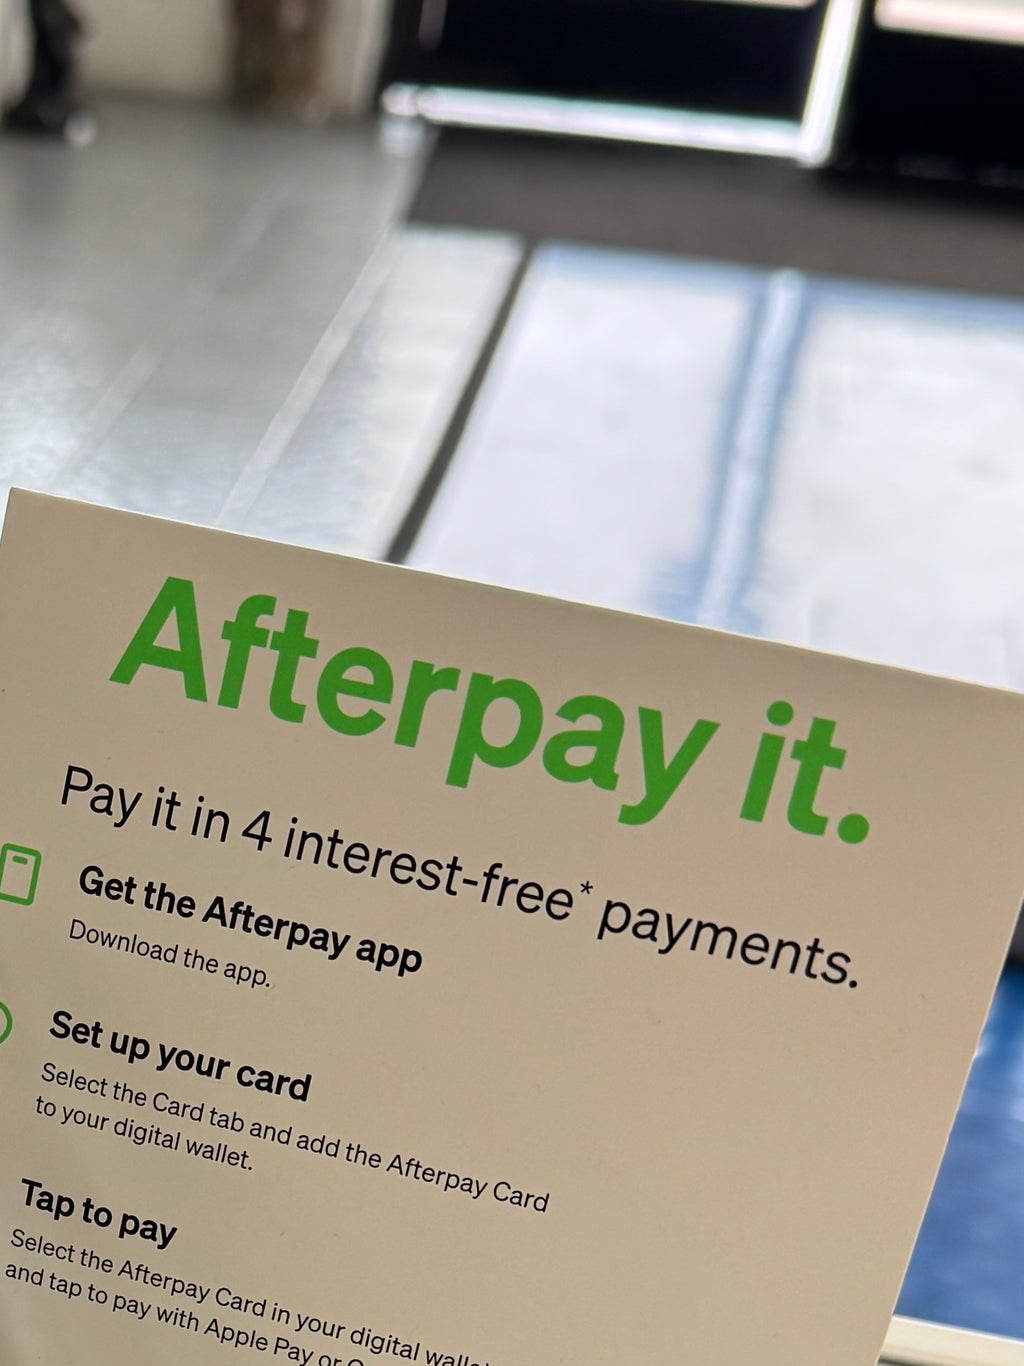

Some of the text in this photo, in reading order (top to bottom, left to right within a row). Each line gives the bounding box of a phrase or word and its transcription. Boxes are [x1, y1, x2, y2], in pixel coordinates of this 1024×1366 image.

[109, 576, 870, 844] Afterpay it.
[61, 764, 143, 828] Pay
[151, 785, 182, 832] it
[190, 795, 230, 843] in
[241, 810, 273, 852] 4
[597, 899, 858, 989] payments.
[79, 865, 423, 978] Get the Afterpay app
[69, 918, 270, 989] Download the app.
[49, 1010, 313, 1103] Set up your card
[36, 1095, 253, 1171] to your digital wallet.
[41, 1062, 550, 1213] Select the Card tab and add the Afterpay Card
[21, 1177, 178, 1250] Tap to pay
[5, 1263, 45, 1287] and
[49, 1272, 82, 1300] tap
[87, 1283, 108, 1305] to
[112, 1294, 152, 1320] pay
[156, 1306, 200, 1332] with
[203, 1318, 269, 1352] Apple
[273, 1336, 315, 1366] Pay
[10, 1228, 76, 1264] Select
[80, 1248, 114, 1274] the
[117, 1259, 211, 1305] Afterpay
[215, 1287, 267, 1318] Card
[271, 1302, 291, 1325] in
[294, 1313, 346, 1339] your
[350, 1327, 421, 1361] digital
